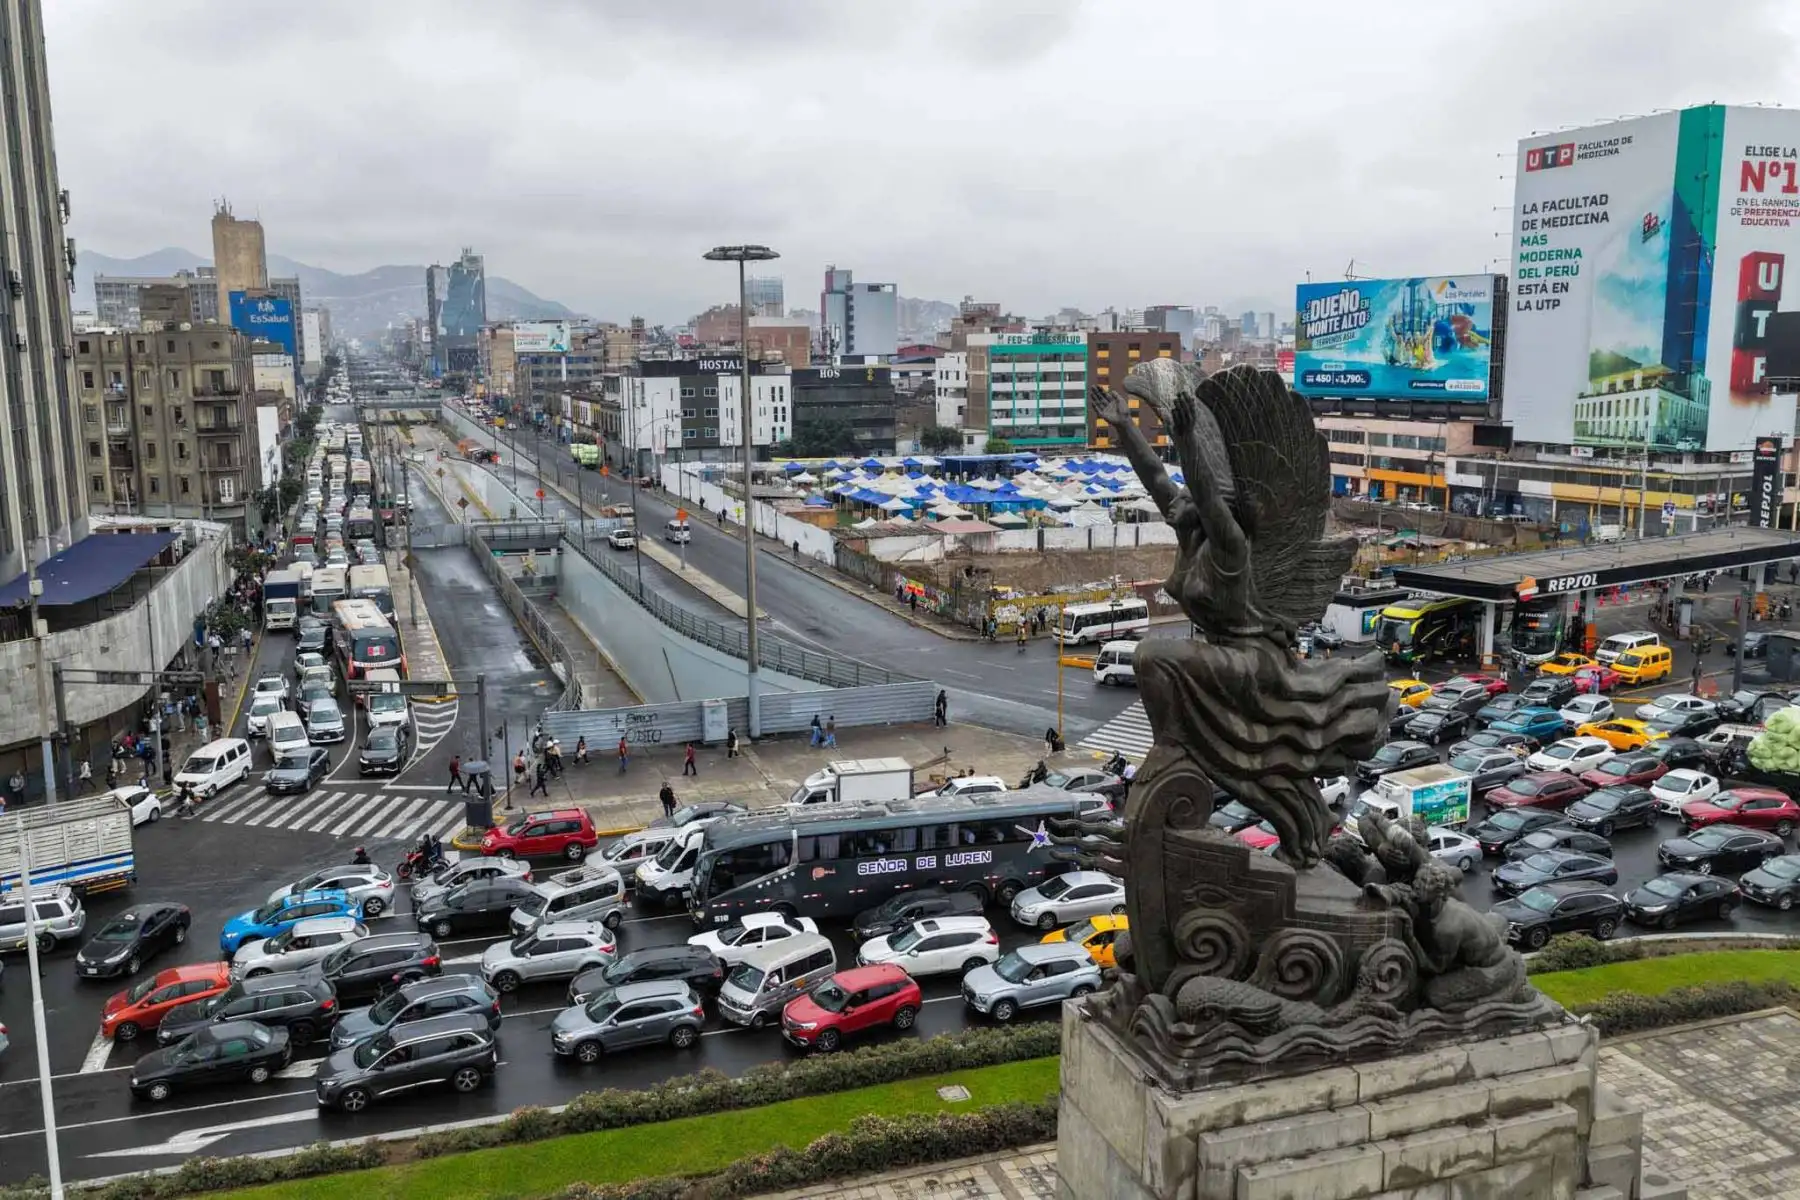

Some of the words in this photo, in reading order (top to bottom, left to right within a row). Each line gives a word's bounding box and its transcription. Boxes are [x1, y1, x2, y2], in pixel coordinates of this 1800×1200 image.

[1578, 138, 1619, 151] FACULTAD
[1621, 136, 1633, 144] DE
[1529, 148, 1571, 167] UTP
[1577, 147, 1620, 160] MEDICINA
[1745, 146, 1780, 157] ELIGE
[1783, 148, 1797, 158] LA
[1522, 203, 1538, 215] LA
[1542, 194, 1609, 213] FACULTAD
[1737, 198, 1748, 206] EN
[1750, 198, 1760, 207] EL
[1762, 199, 1800, 208] RANKING
[1731, 208, 1741, 216] DE
[1522, 219, 1538, 231] DE
[1541, 211, 1609, 229] MEDICINA
[1741, 218, 1790, 227] EDUCATIVA
[1520, 232, 1548, 247] MÁS
[1520, 248, 1582, 263] MODERNA
[1518, 268, 1542, 279] DEL
[1545, 261, 1579, 277] PERÚ
[1518, 280, 1548, 295] ESTÁ
[1552, 282, 1569, 293] EN
[1311, 289, 1360, 321] DUEÑO
[1517, 300, 1532, 311] LA
[1536, 299, 1560, 310] UTP
[251, 315, 288, 323] EsSalud
[1307, 318, 1340, 338] MONTE
[700, 360, 743, 370] HOSTAL
[820, 369, 840, 378] HOS
[1316, 374, 1331, 382] 450
[1760, 475, 1773, 528] REPSOL
[1548, 574, 1598, 592] REPSOL
[858, 858, 907, 875] SEÑOR
[916, 856, 937, 870] DE
[945, 850, 992, 867] LUREN
